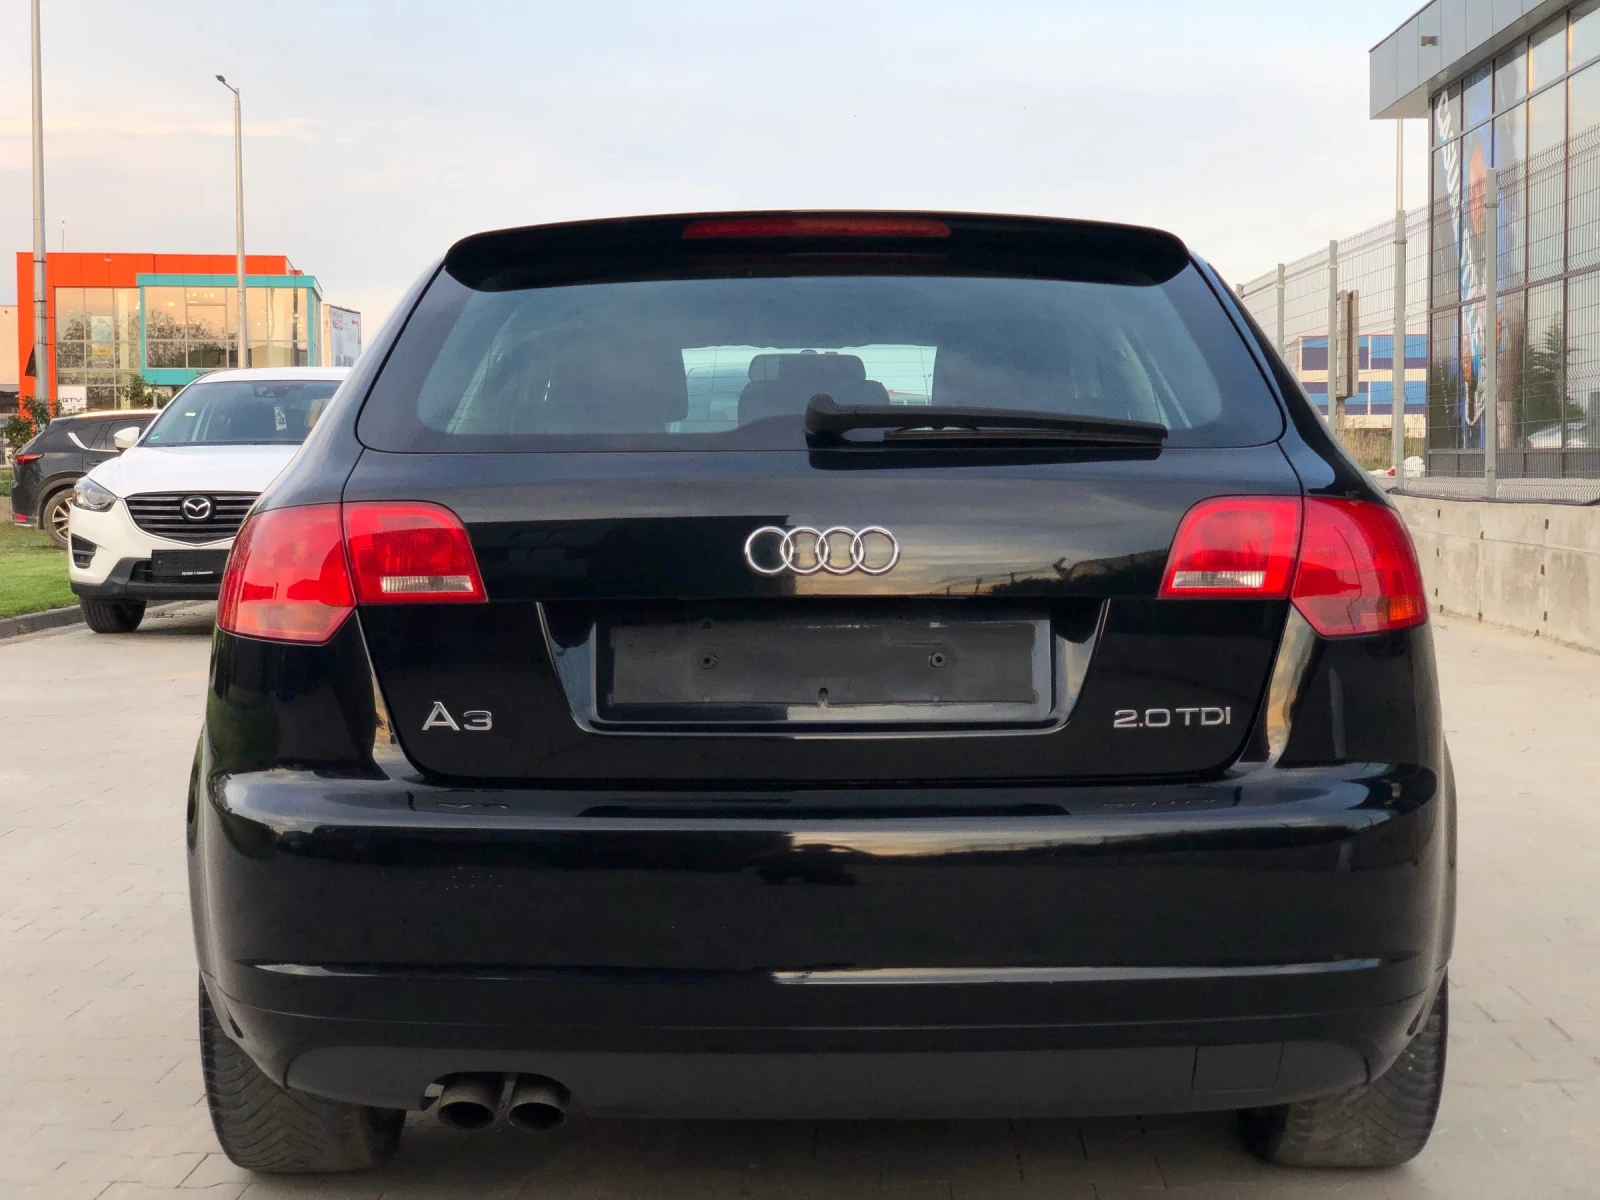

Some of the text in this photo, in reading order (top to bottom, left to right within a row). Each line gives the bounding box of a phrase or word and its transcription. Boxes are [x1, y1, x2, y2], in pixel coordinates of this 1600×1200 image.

[421, 701, 492, 731] A3
[1113, 706, 1231, 728] 2.0 TDI
